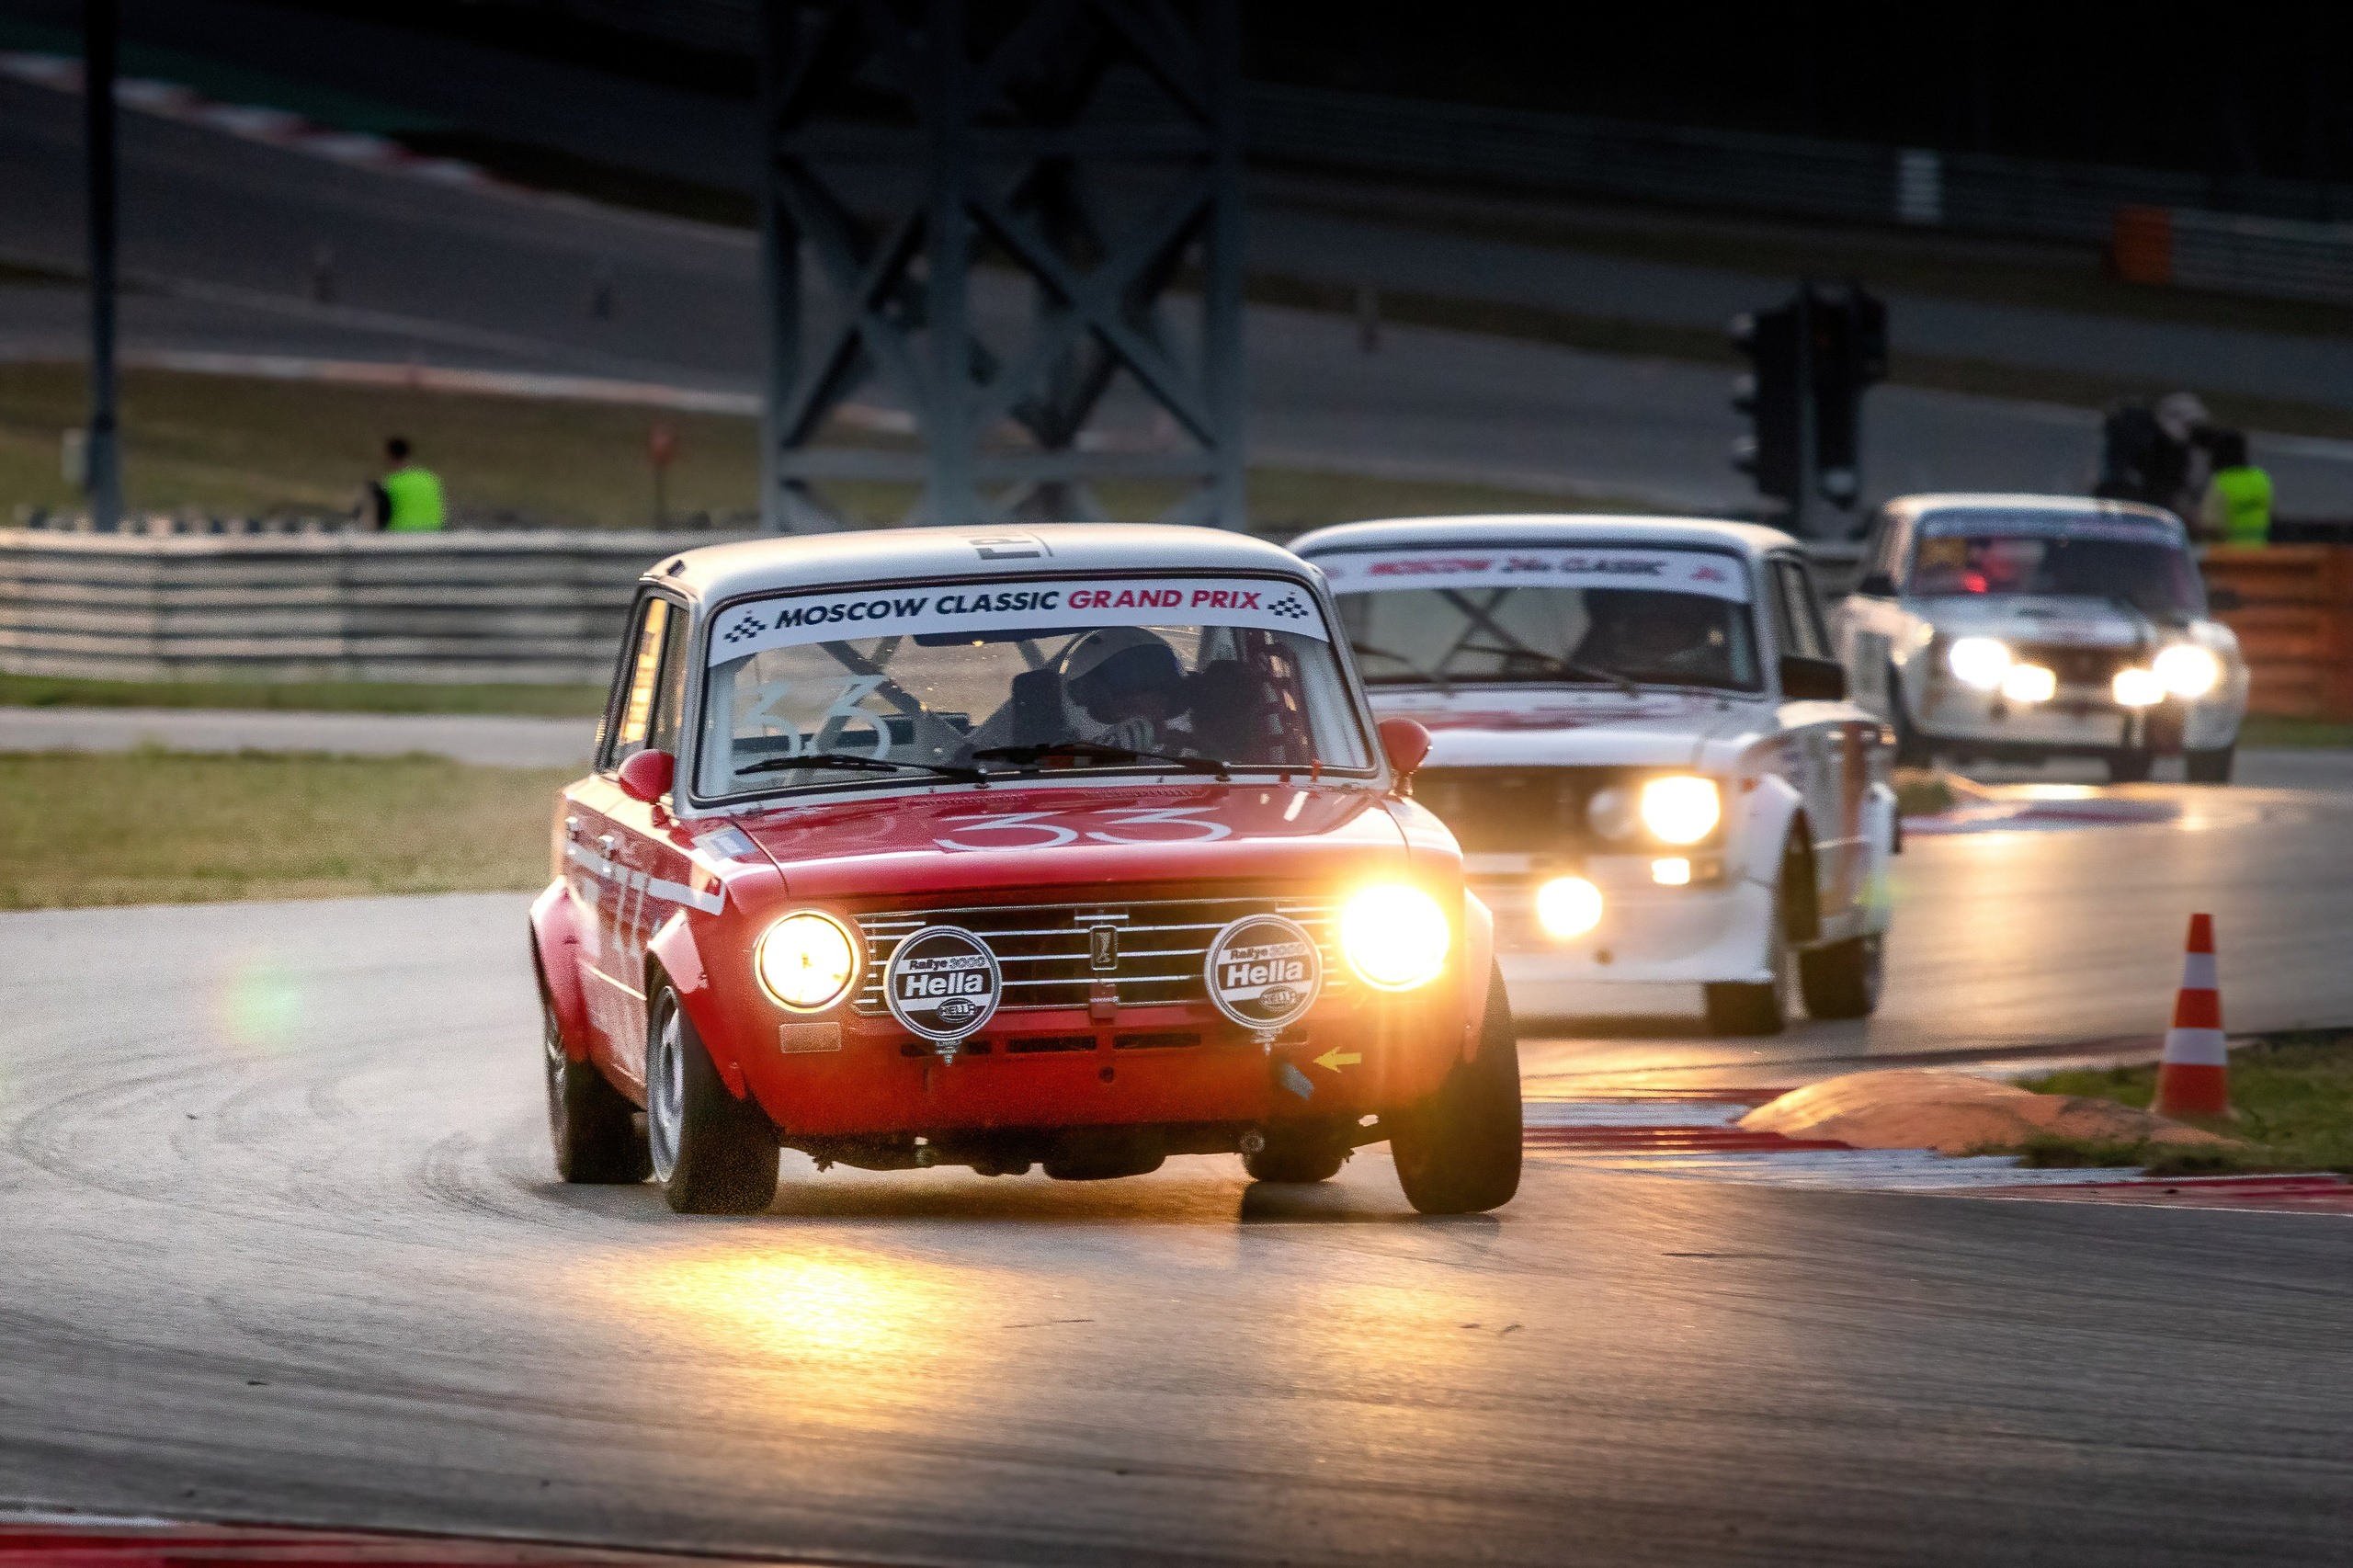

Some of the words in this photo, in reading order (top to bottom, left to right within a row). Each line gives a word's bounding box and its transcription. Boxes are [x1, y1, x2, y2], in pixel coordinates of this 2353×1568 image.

[774, 597, 928, 630] MOSCOW
[936, 590, 1060, 616] CLASSIC
[1067, 589, 1183, 609] GRAND
[1189, 589, 1262, 610] PRIX
[931, 806, 1233, 852] 33
[909, 960, 948, 971] Rallye
[1231, 948, 1267, 960] Rallye
[904, 971, 983, 997] Hella
[1226, 960, 1303, 988] Hella
